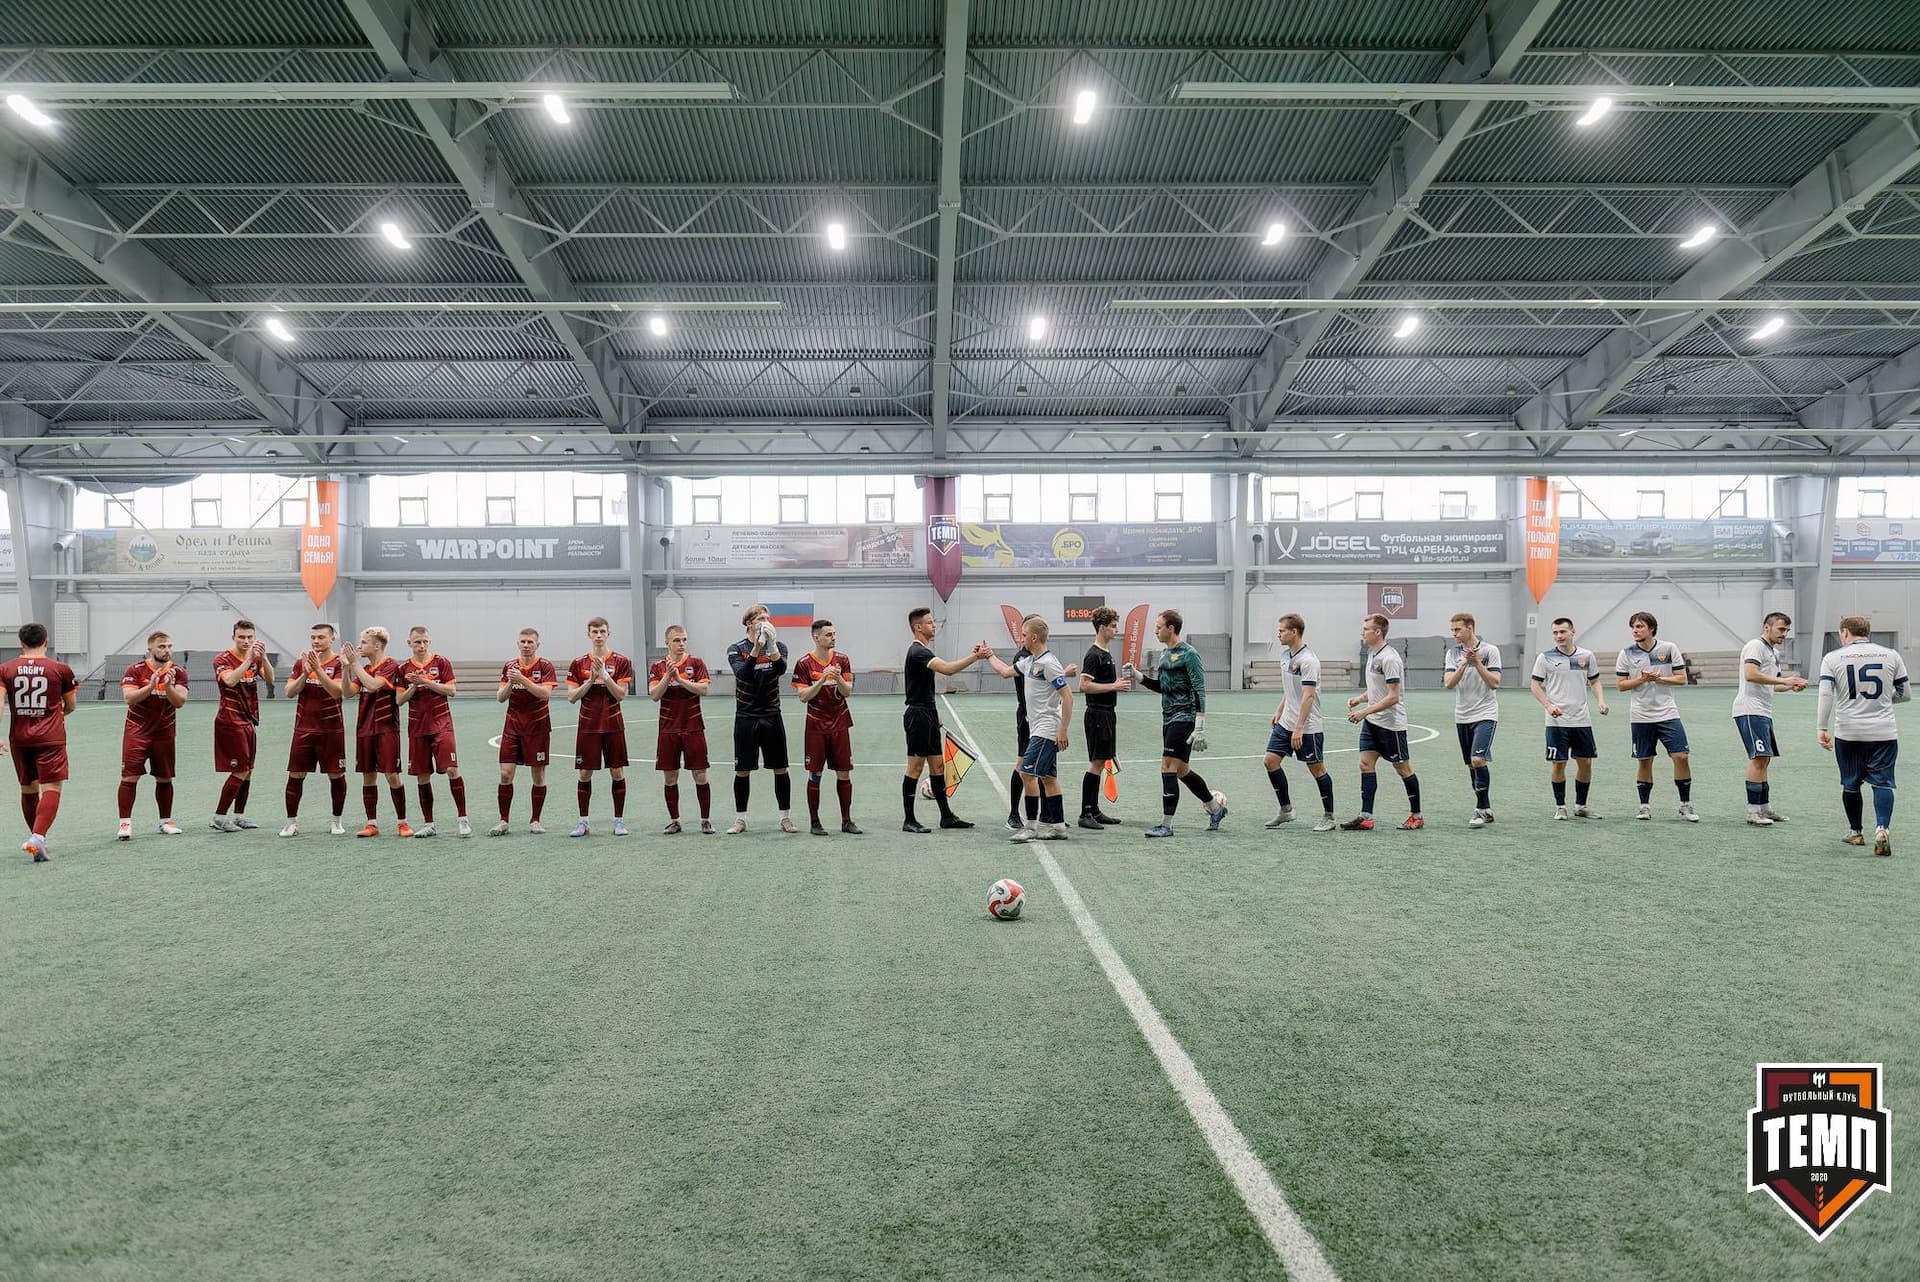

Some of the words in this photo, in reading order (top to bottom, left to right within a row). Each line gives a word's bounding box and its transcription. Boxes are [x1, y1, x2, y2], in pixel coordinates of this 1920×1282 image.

[931, 526, 957, 540] ТЕМП
[1380, 533, 1442, 545] Футбольная
[1443, 533, 1504, 544] экипировка
[307, 535, 331, 549] ОДНА
[1300, 531, 1381, 551] JÖGEL
[416, 538, 560, 560] WARPOINT
[1385, 545, 1407, 555] ТРЦ
[1846, 663, 1884, 700] 15
[14, 675, 48, 709] 22
[1755, 739, 1766, 752] 6
